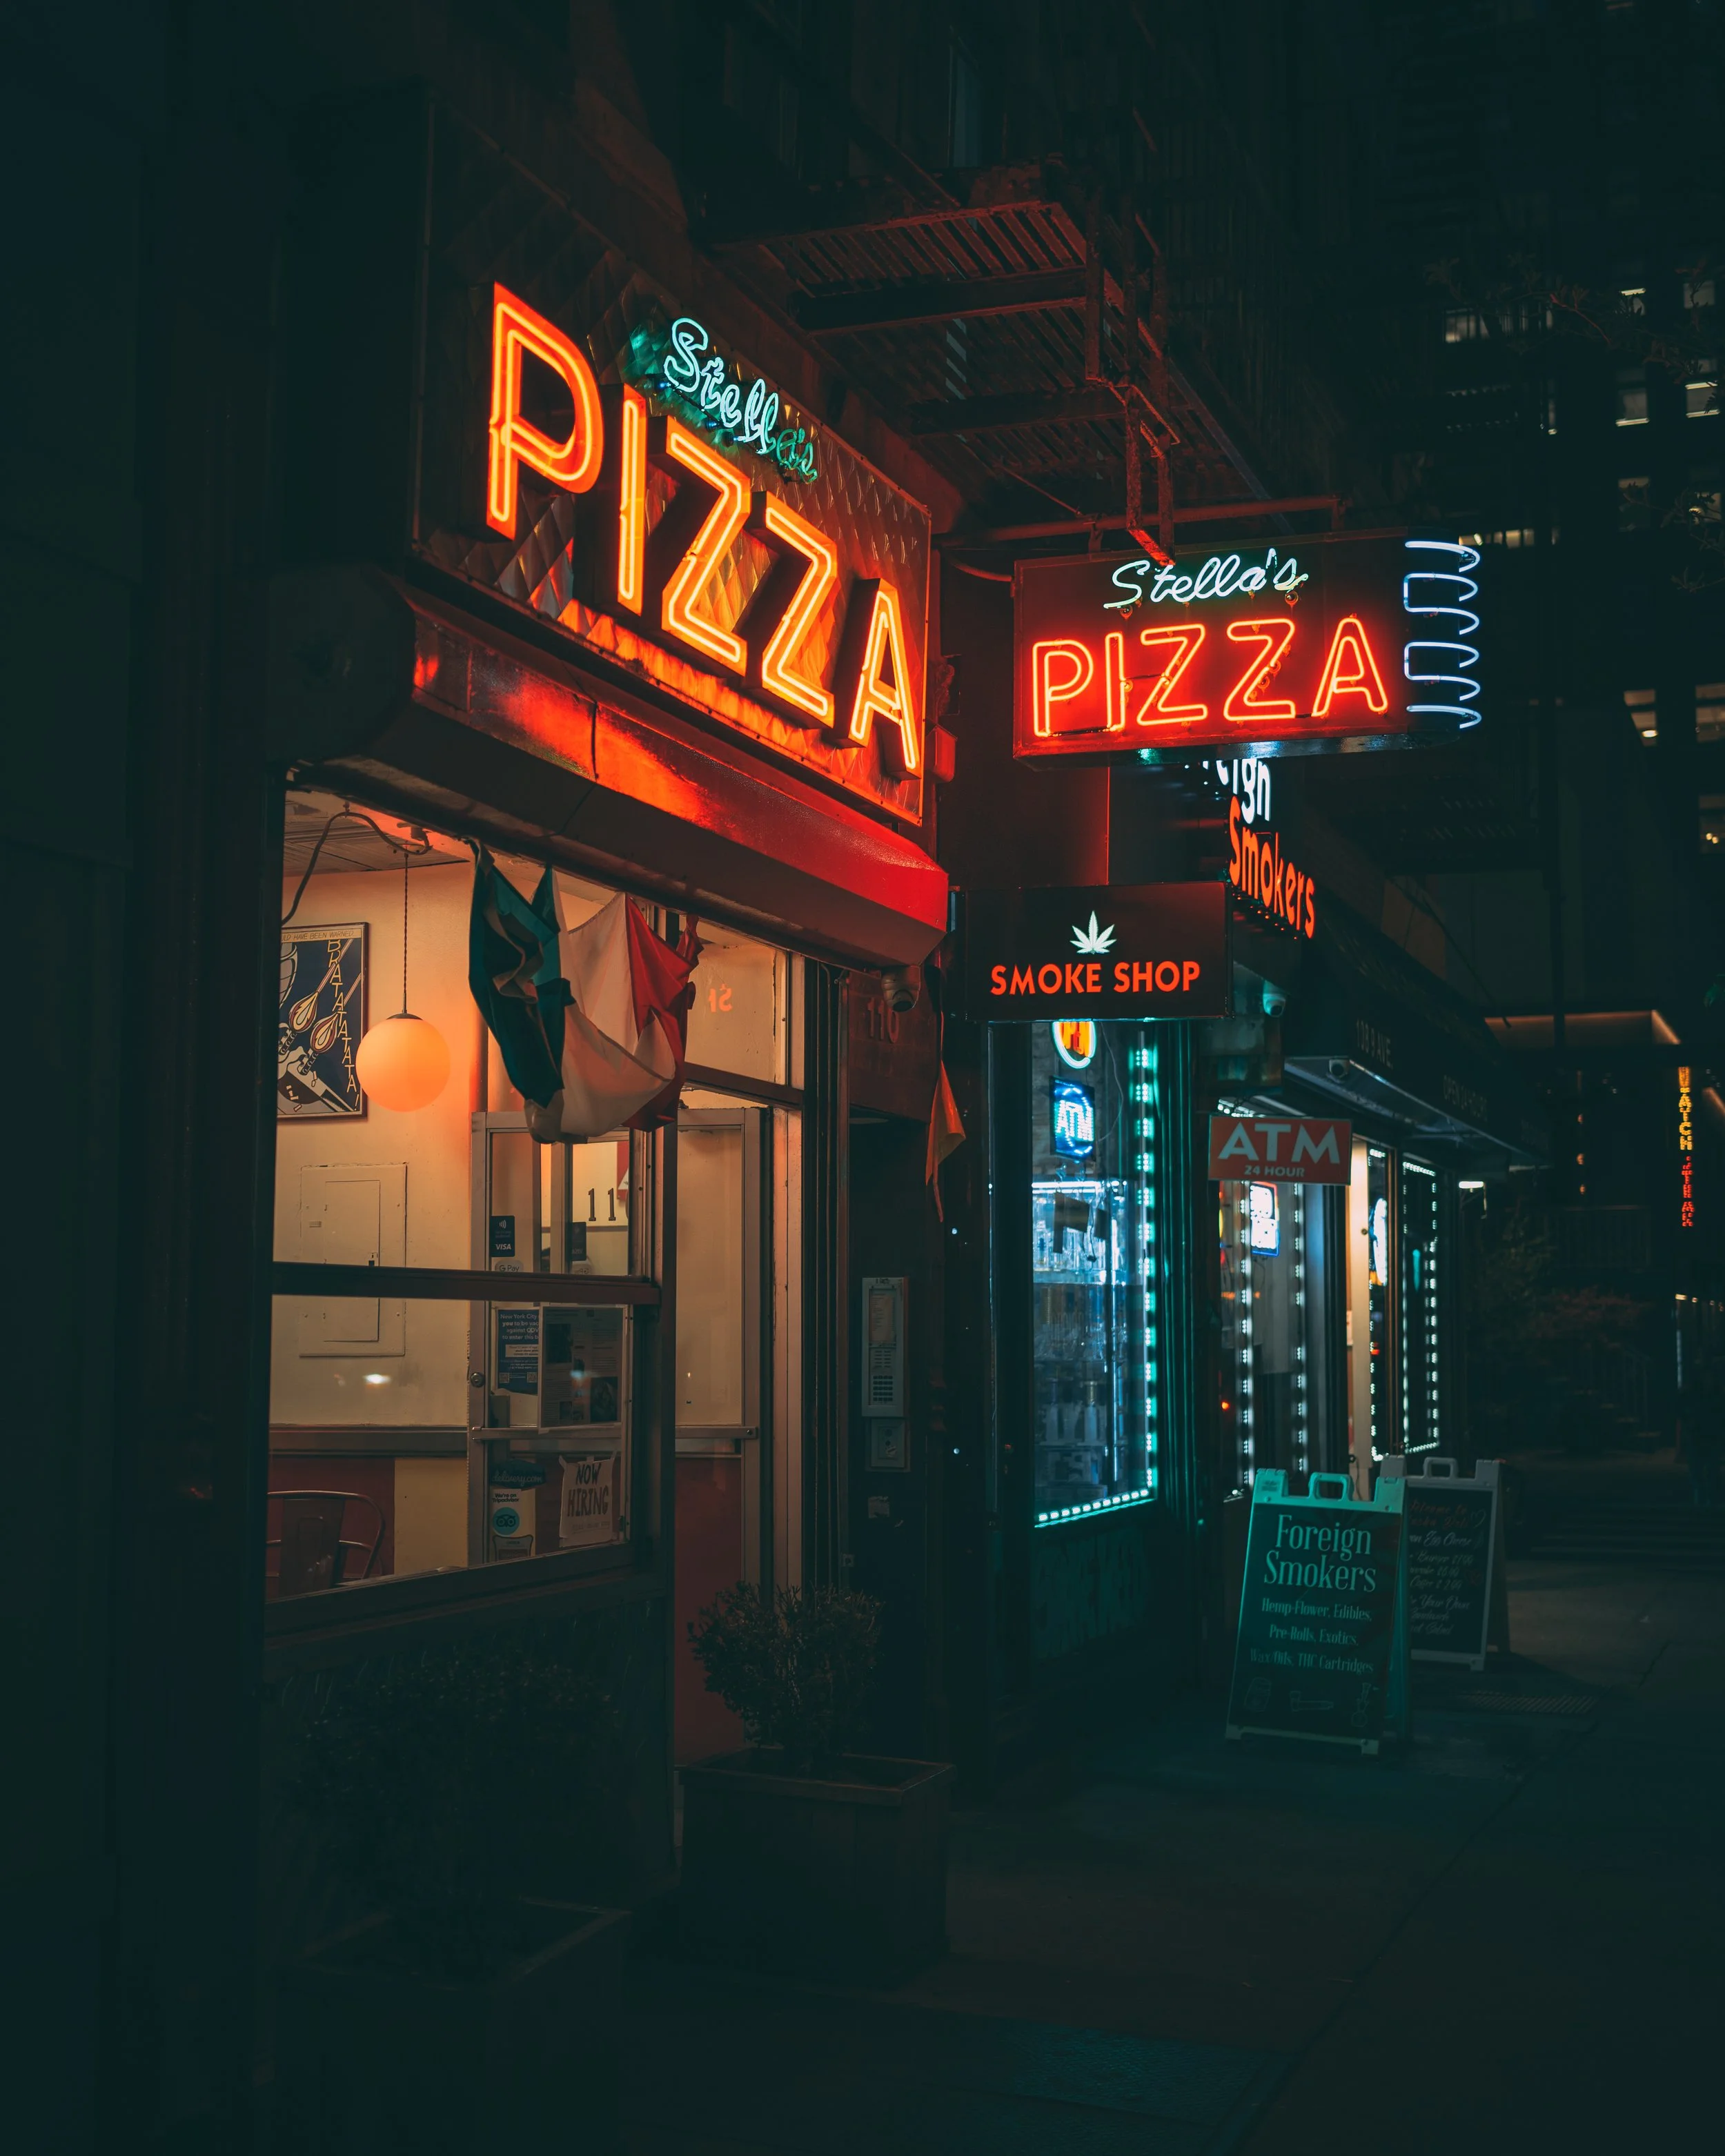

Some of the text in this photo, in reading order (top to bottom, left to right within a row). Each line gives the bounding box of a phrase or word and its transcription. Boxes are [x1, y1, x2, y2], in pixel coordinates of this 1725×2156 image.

[664, 317, 818, 484] Stella's
[486, 281, 922, 779] PIZZA
[1103, 548, 1308, 609] Stella's
[1032, 617, 1388, 737] PIZZA
[1229, 795, 1315, 939] Smokers
[990, 960, 1201, 996] SMOKE SHOP
[1056, 1100, 1094, 1142] ATM
[1217, 1121, 1340, 1165] ATM
[1244, 1165, 1305, 1178] 24 HOUR
[507, 1264, 520, 1272] Pay
[491, 1470, 542, 1487] delivery.com
[575, 1463, 602, 1485] NOW
[567, 1485, 609, 1517] HIRING
[1275, 1514, 1372, 1562] Foreign
[1264, 1550, 1377, 1593] Smokers
[1261, 1597, 1372, 1622] Hemp-Flower, Edibles,
[1269, 1623, 1317, 1645] Pre-Rolls,
[1297, 1652, 1318, 1668] THC
[1319, 1654, 1374, 1675] Cartridges
